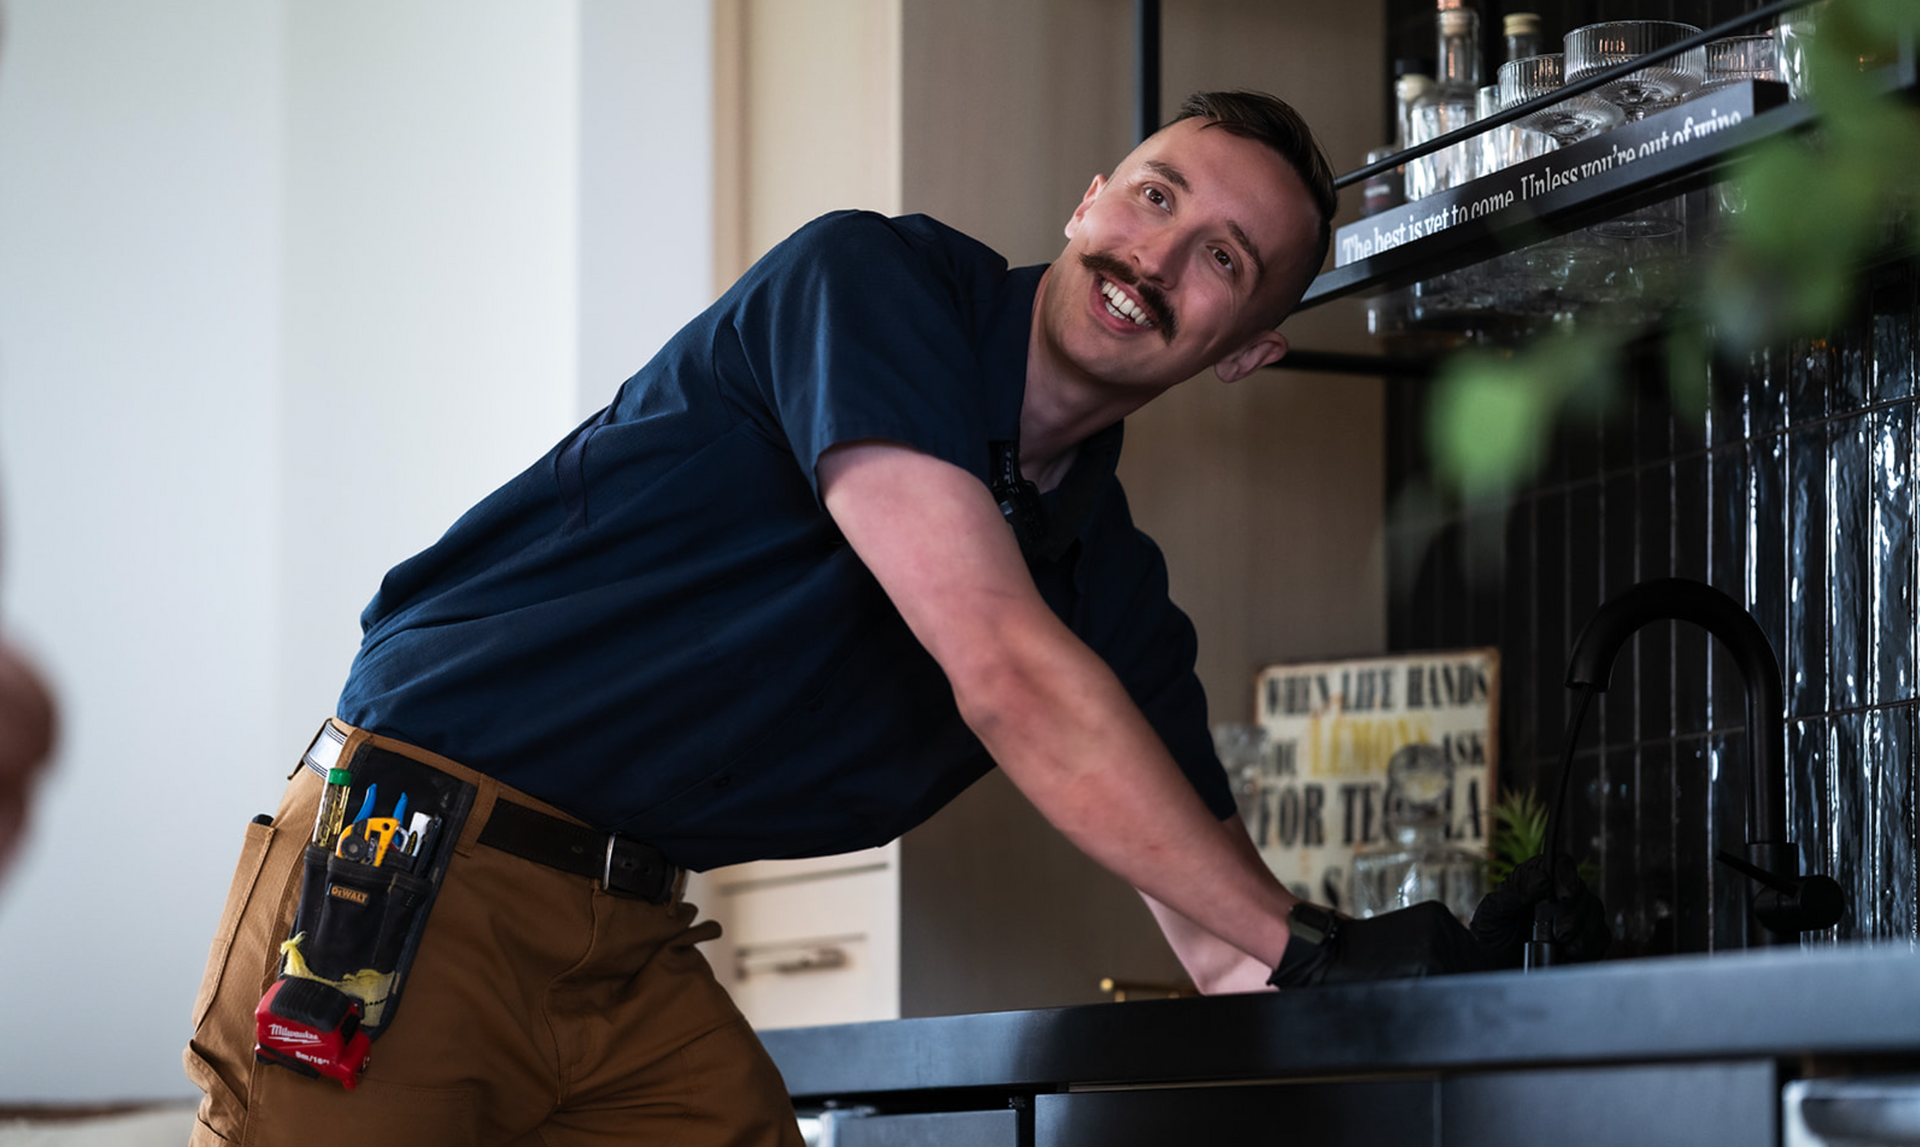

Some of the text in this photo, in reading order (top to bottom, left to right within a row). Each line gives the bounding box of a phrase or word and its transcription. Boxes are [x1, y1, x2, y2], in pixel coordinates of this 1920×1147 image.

[1342, 234, 1372, 264] The
[1374, 227, 1405, 254] best
[1409, 215, 1422, 241] is
[1425, 207, 1449, 236] yet
[1451, 204, 1468, 226] to
[1521, 167, 1578, 200] Unless
[1266, 664, 1488, 717] WHEN LIFE HANDS
[1256, 778, 1483, 847] FOR TELA
[268, 1023, 319, 1040] Milwaukee
